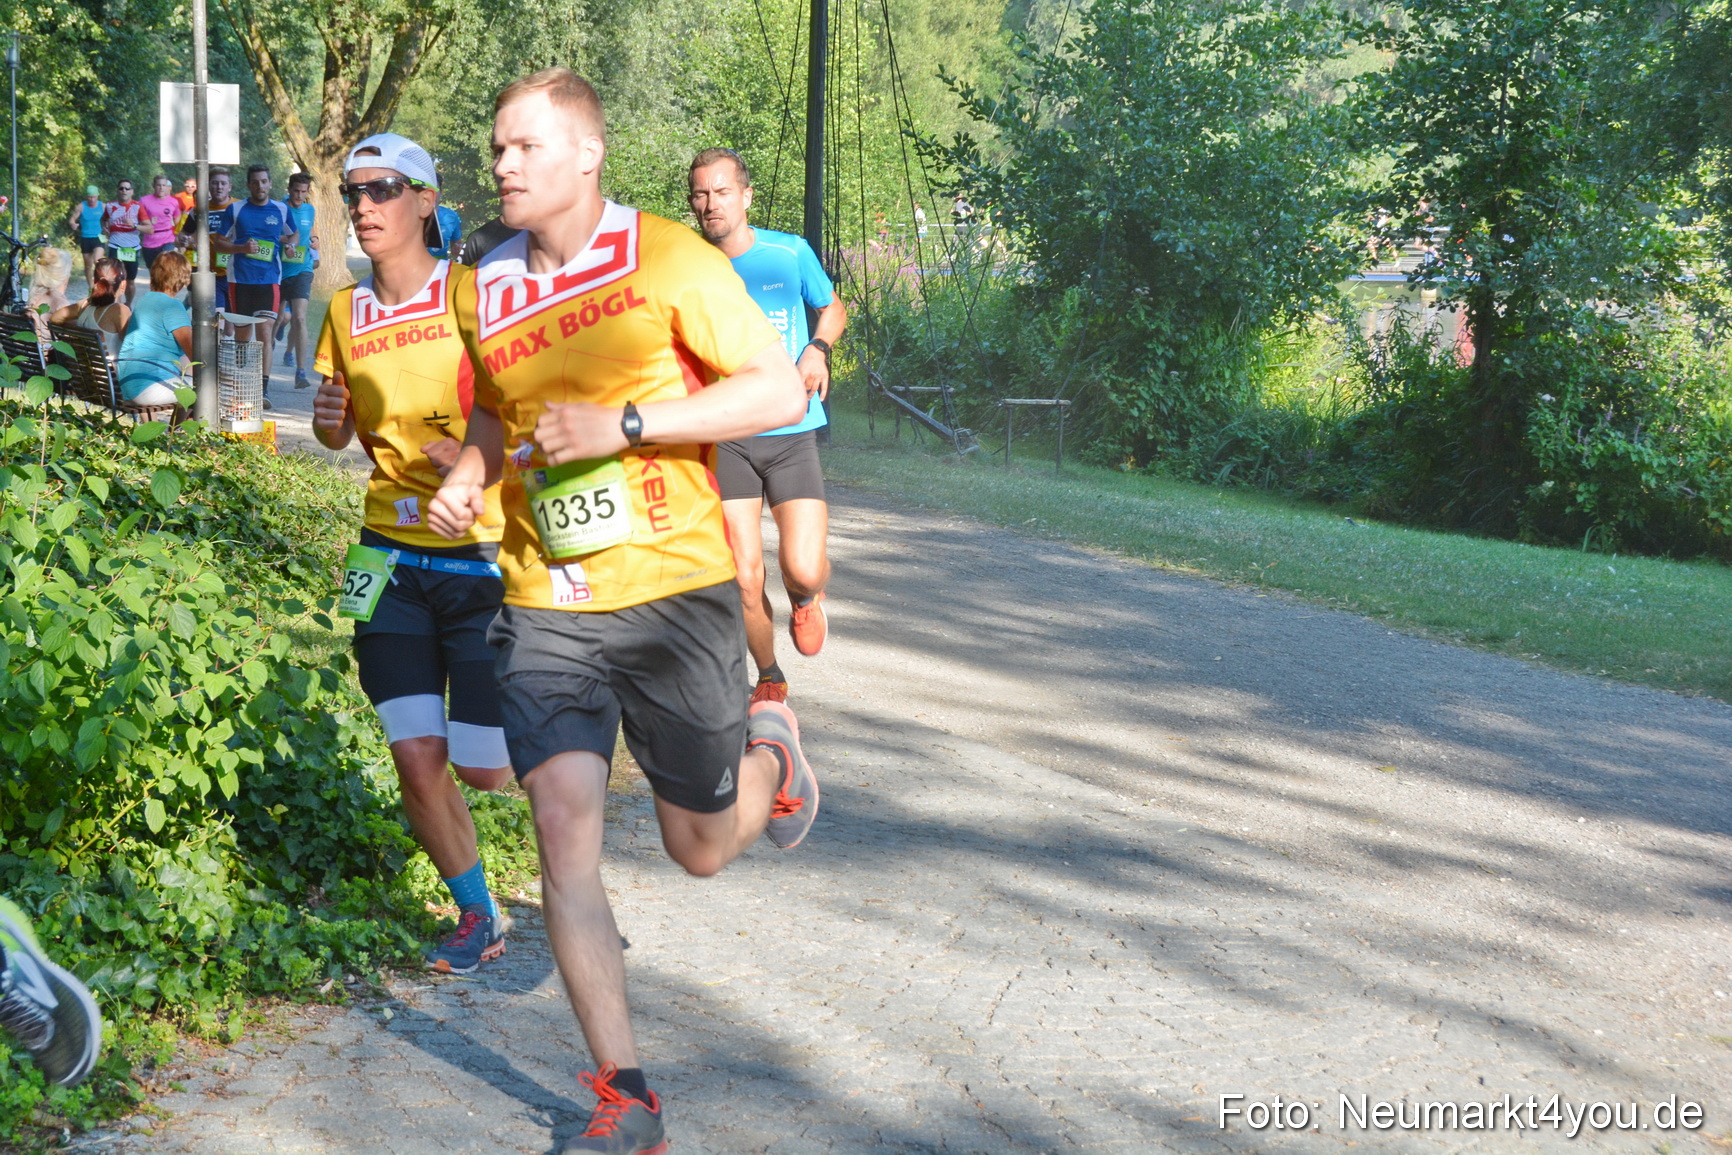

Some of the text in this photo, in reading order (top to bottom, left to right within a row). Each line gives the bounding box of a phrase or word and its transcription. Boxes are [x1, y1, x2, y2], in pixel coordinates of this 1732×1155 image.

[762, 282, 784, 292] Ronny
[351, 324, 452, 361] MAX BÖGL
[482, 285, 647, 379] MAX BÖGL
[538, 488, 616, 532] 1335
[443, 561, 470, 572] sailfish
